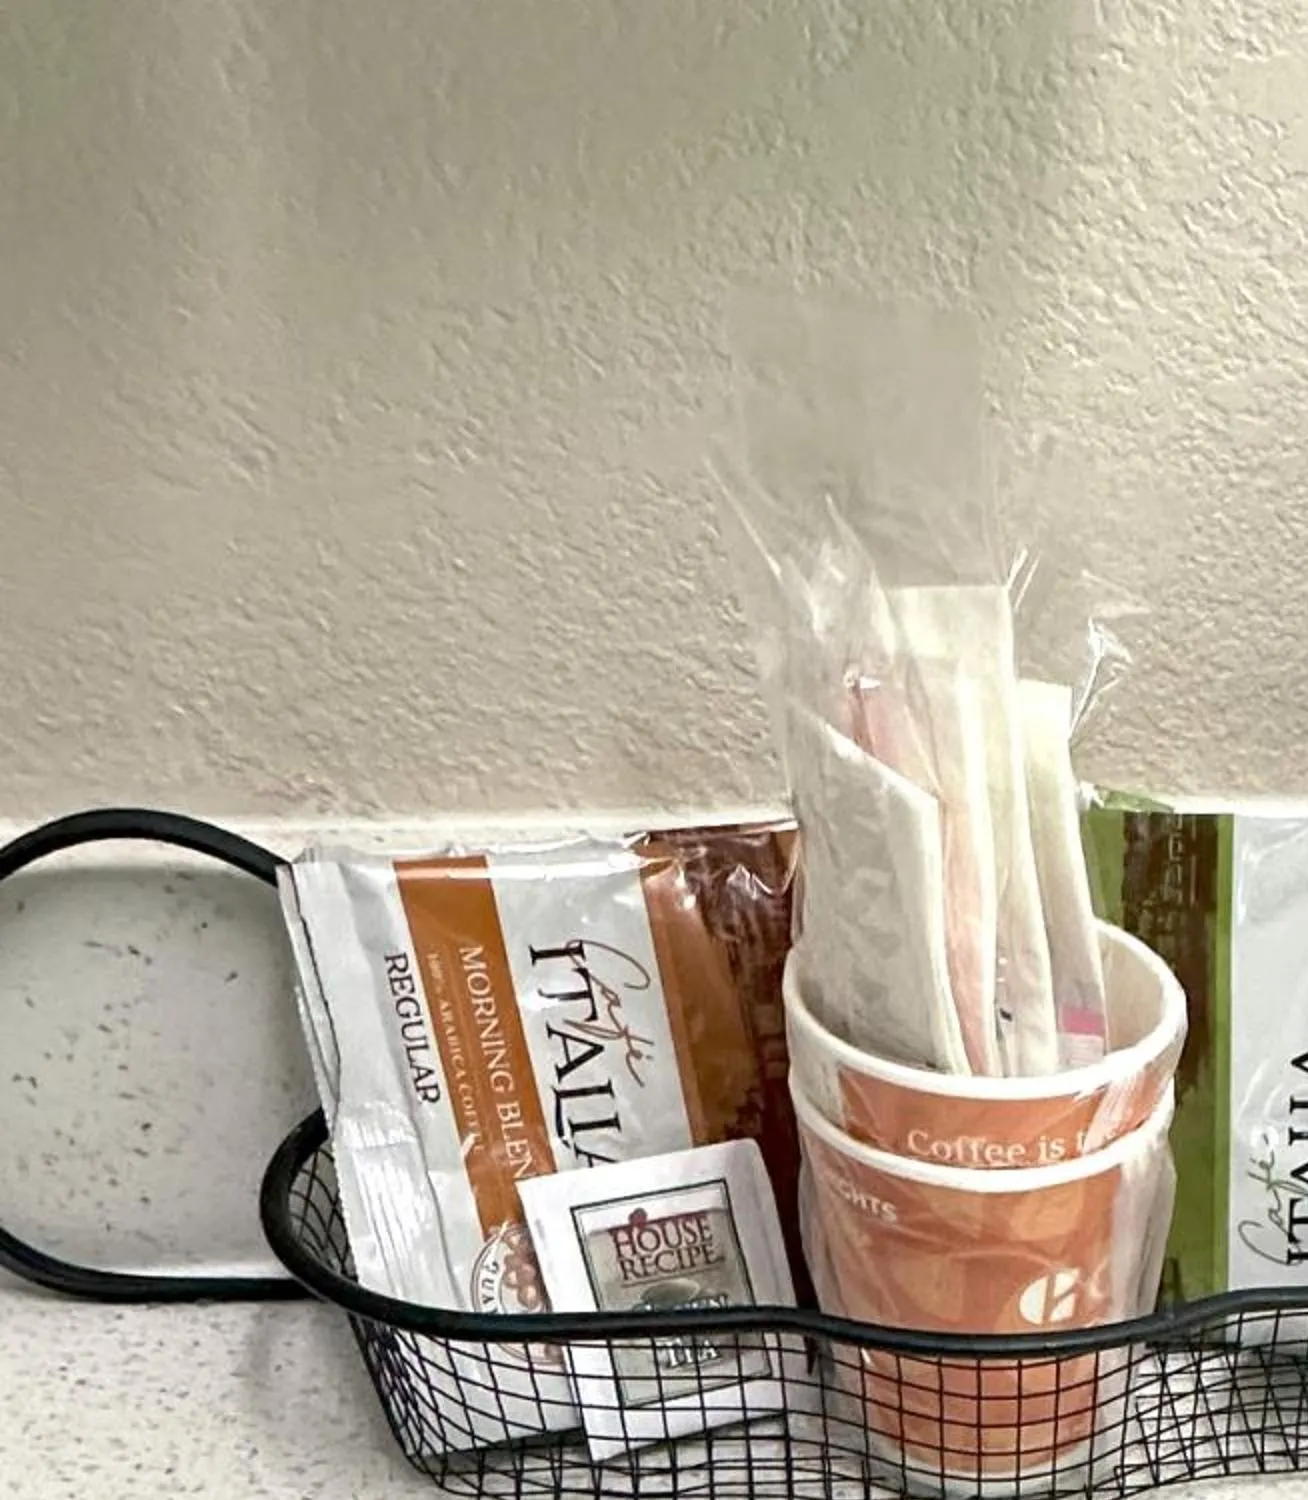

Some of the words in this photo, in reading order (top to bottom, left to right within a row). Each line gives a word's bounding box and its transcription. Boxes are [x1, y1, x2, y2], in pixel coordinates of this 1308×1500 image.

[383, 951, 442, 1105] REGULAR
[439, 1000, 467, 1079] ARABICA
[457, 1081, 485, 1152] COFFEE
[459, 944, 516, 1094] MORNING
[496, 1101, 535, 1179] BLEN
[906, 1128, 1027, 1166] Coffee
[1038, 1134, 1066, 1163] is
[611, 1212, 715, 1259] HOUSE
